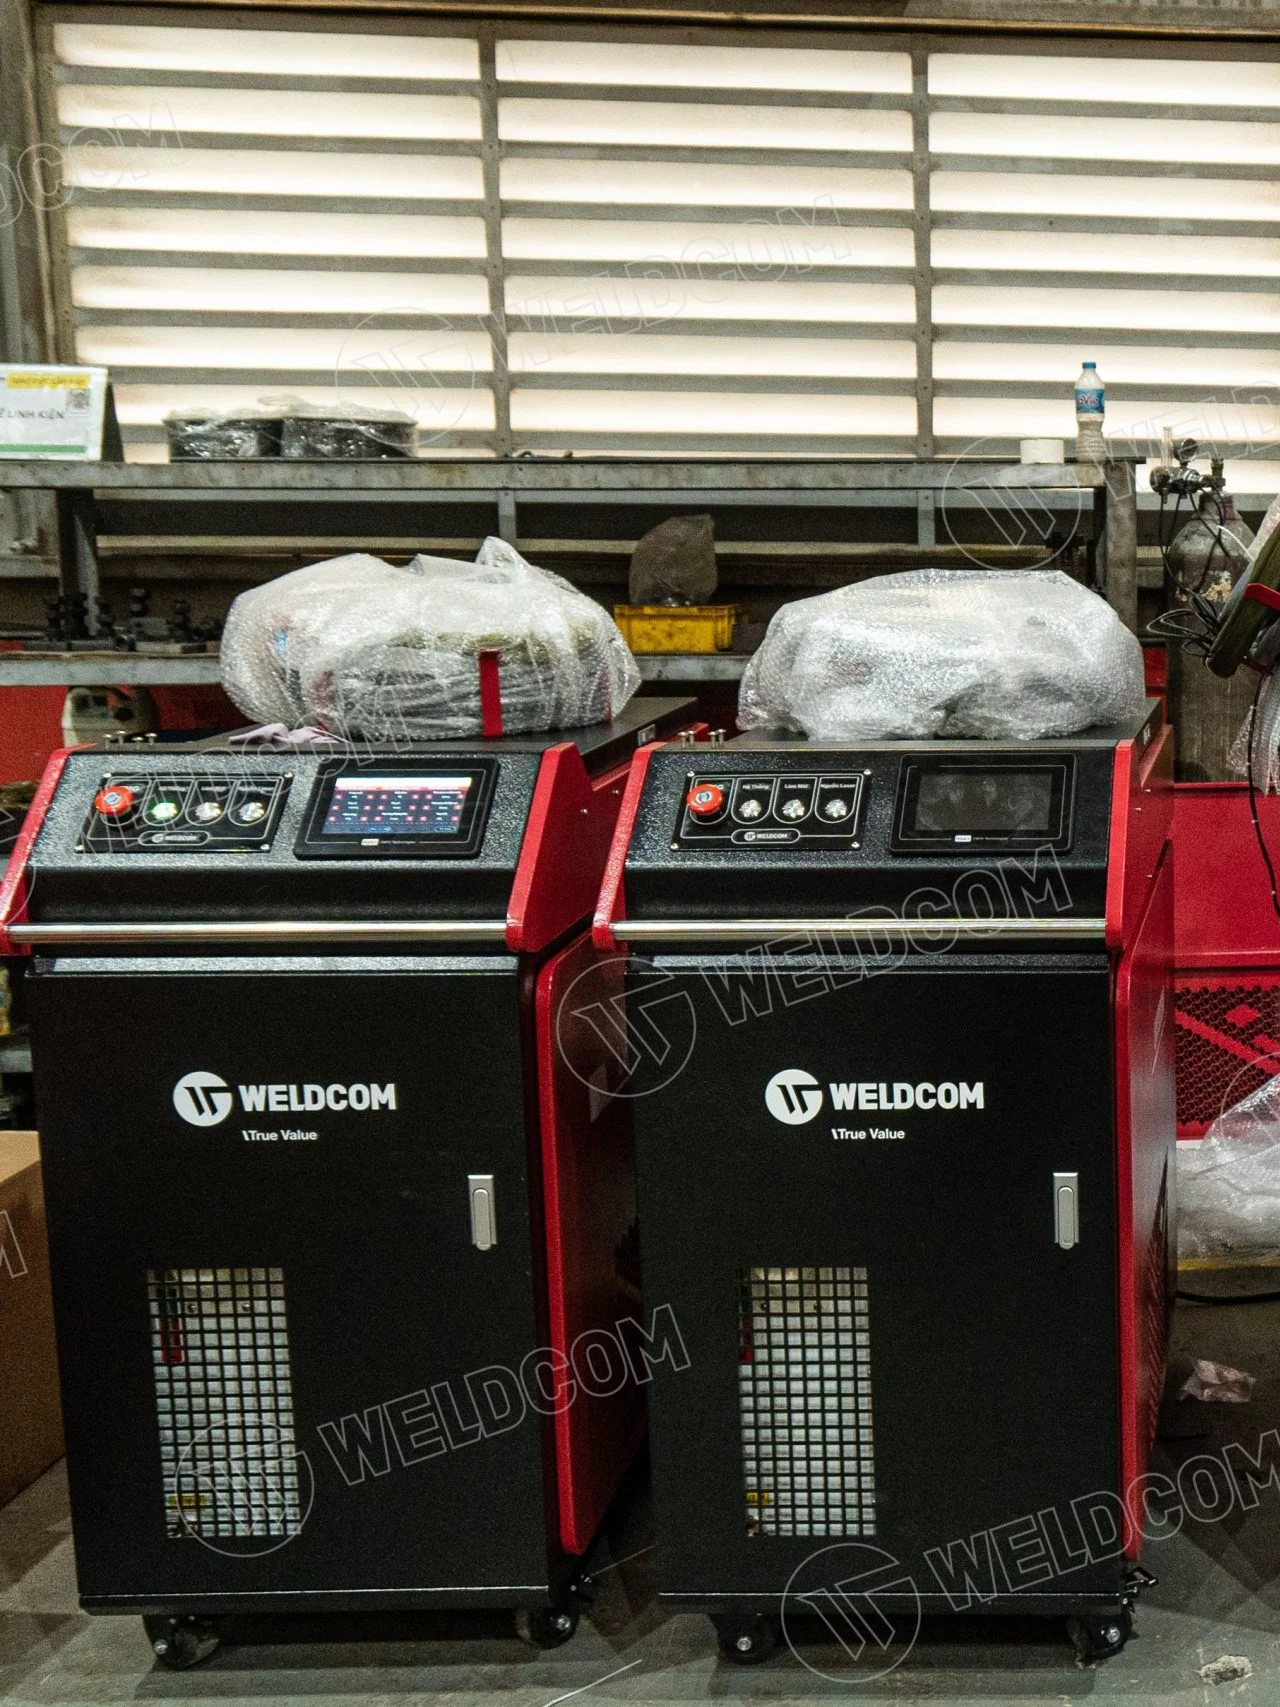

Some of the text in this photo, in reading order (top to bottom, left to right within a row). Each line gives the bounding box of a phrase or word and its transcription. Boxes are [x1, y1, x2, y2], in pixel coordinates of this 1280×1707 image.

[238, 1083, 397, 1111] WELDCOM
[828, 1082, 985, 1110] WELDCOM
[281, 1129, 318, 1140] Value
[869, 1128, 905, 1139] Value
